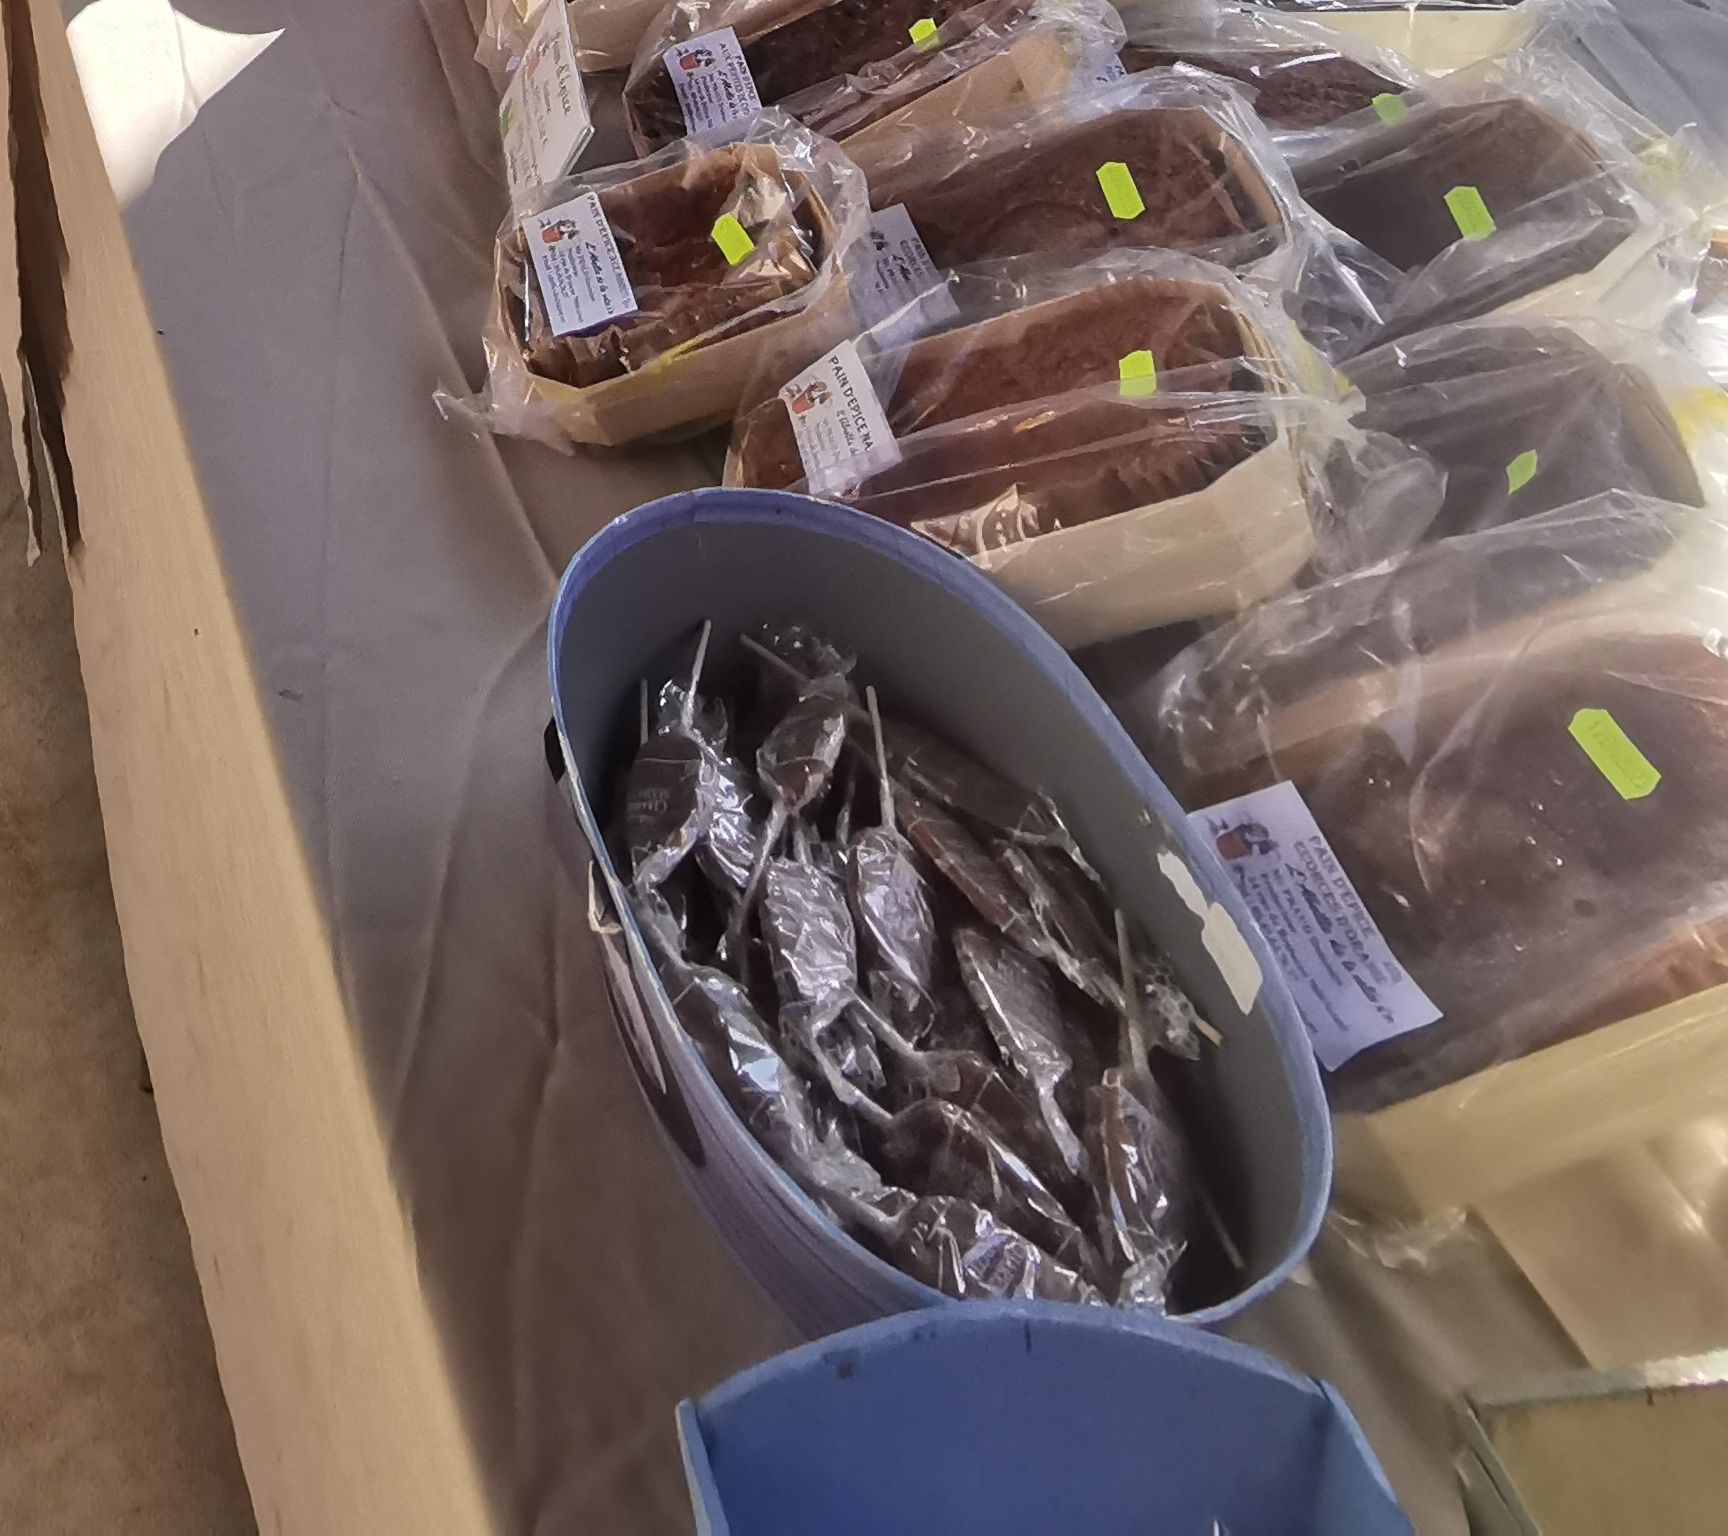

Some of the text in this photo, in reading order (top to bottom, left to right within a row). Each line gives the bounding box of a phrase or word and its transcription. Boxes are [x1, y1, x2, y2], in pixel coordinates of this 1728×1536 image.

[829, 355, 849, 392] PAIN
[843, 387, 869, 435] D'EPICE
[1293, 840, 1345, 914] ECORCES
[1334, 915, 1391, 986] D'ORA
[1309, 834, 1376, 939] PAIN D'EPICE
